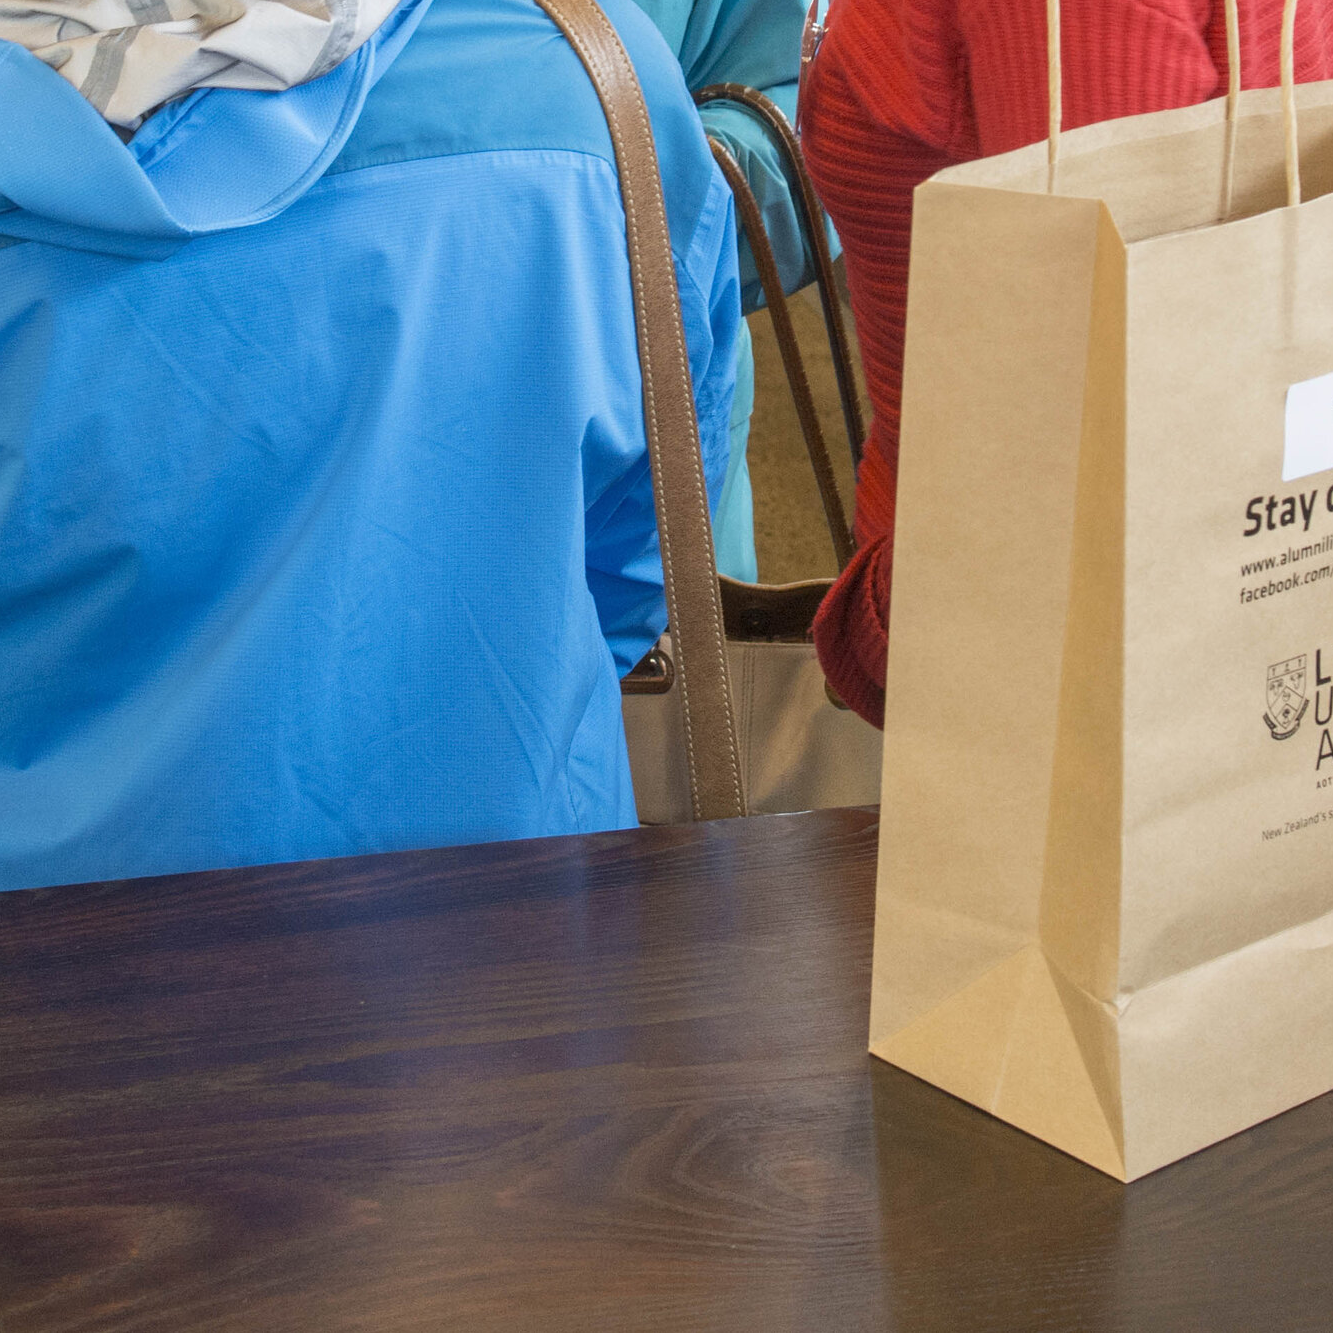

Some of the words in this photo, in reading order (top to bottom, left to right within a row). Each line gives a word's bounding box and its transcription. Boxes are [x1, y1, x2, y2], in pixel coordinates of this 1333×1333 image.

[1243, 488, 1318, 537] Stay
[1261, 825, 1282, 842] New
[1283, 811, 1327, 835] Zealand's
